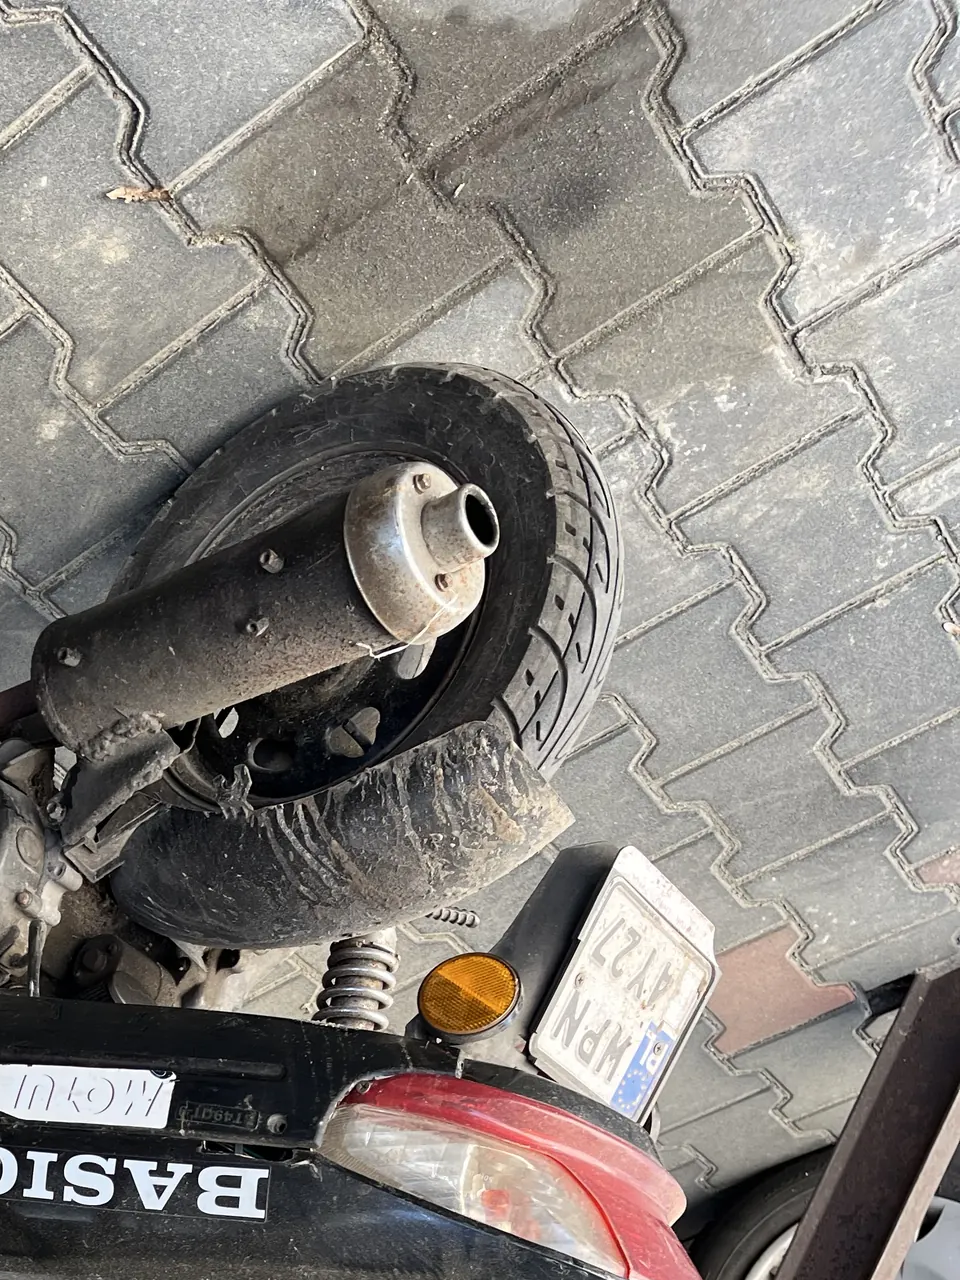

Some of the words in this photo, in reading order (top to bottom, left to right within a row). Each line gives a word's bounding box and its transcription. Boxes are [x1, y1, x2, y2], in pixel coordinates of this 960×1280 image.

[588, 916, 673, 1006] AY27
[550, 991, 631, 1084] WPN
[639, 1029, 668, 1075] PL
